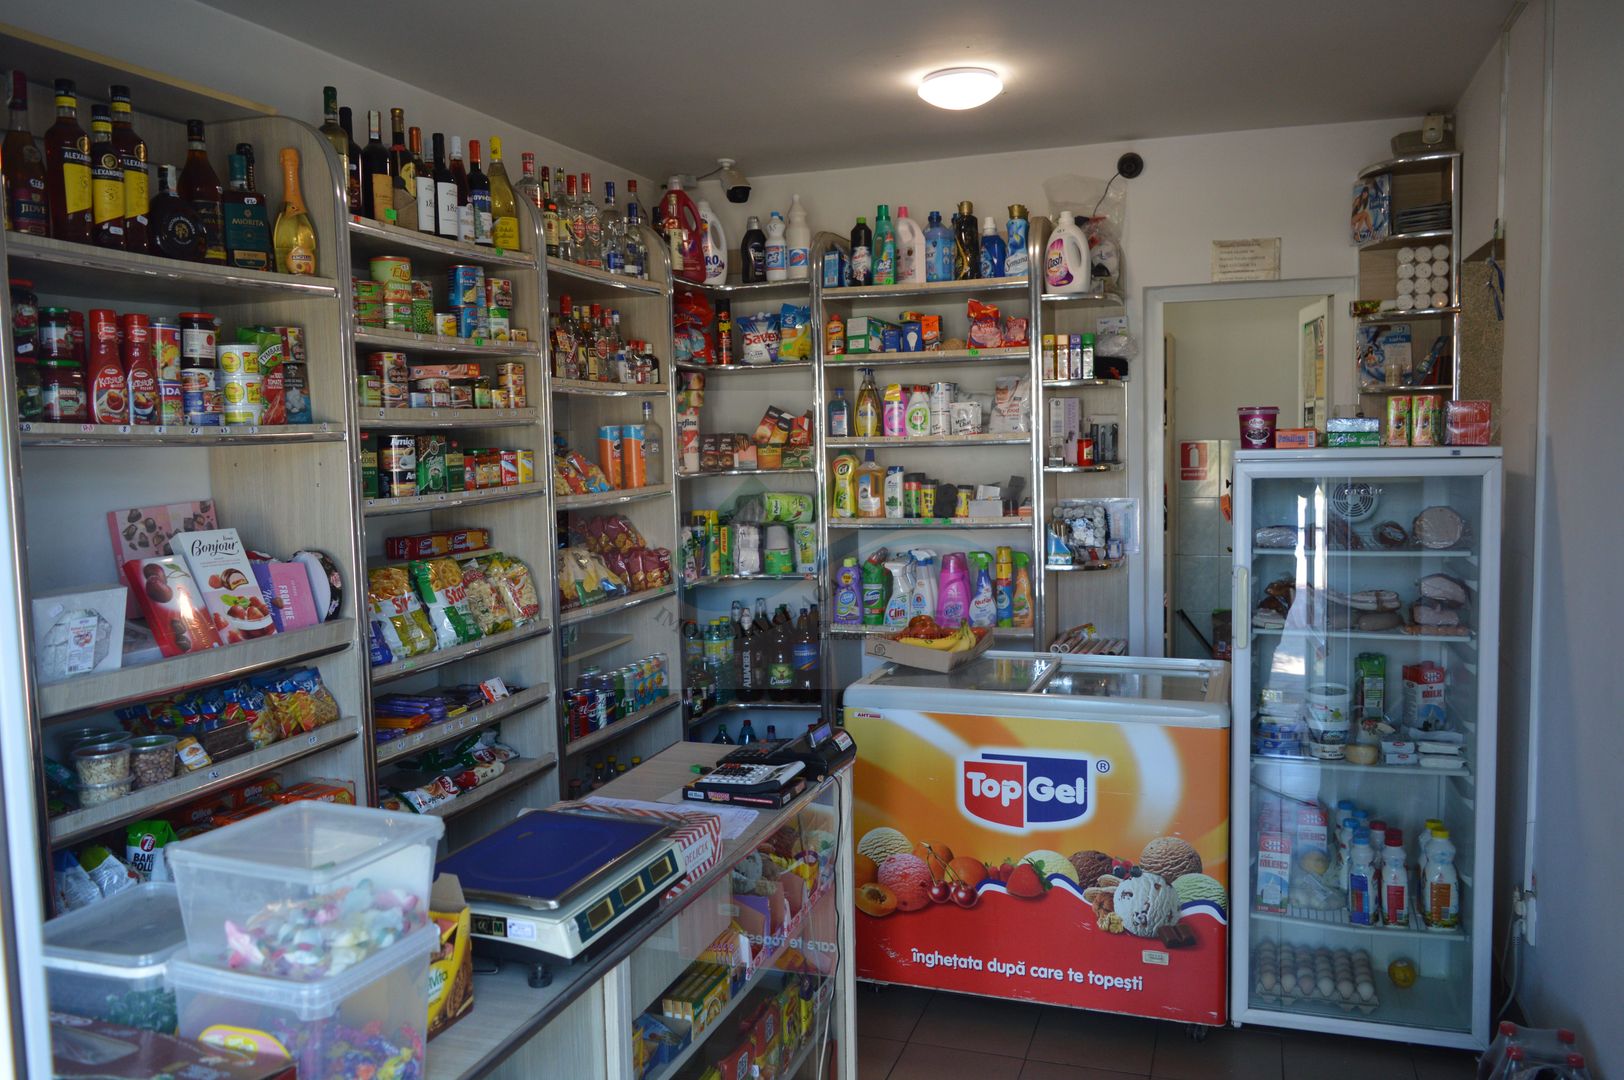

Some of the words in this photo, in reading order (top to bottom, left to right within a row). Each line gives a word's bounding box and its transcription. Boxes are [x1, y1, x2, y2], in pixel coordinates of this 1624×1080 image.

[21, 203, 47, 214] JIDVE
[259, 343, 282, 365] TYMBAR
[191, 539, 239, 557] Bonjour
[284, 606, 296, 620] THE
[889, 607, 906, 618] Clin
[965, 771, 1022, 807] Top
[1028, 776, 1085, 805] Gel
[987, 958, 1026, 977] după
[1029, 965, 1064, 981] care
[1067, 966, 1084, 983] te
[1087, 969, 1144, 992] topești
